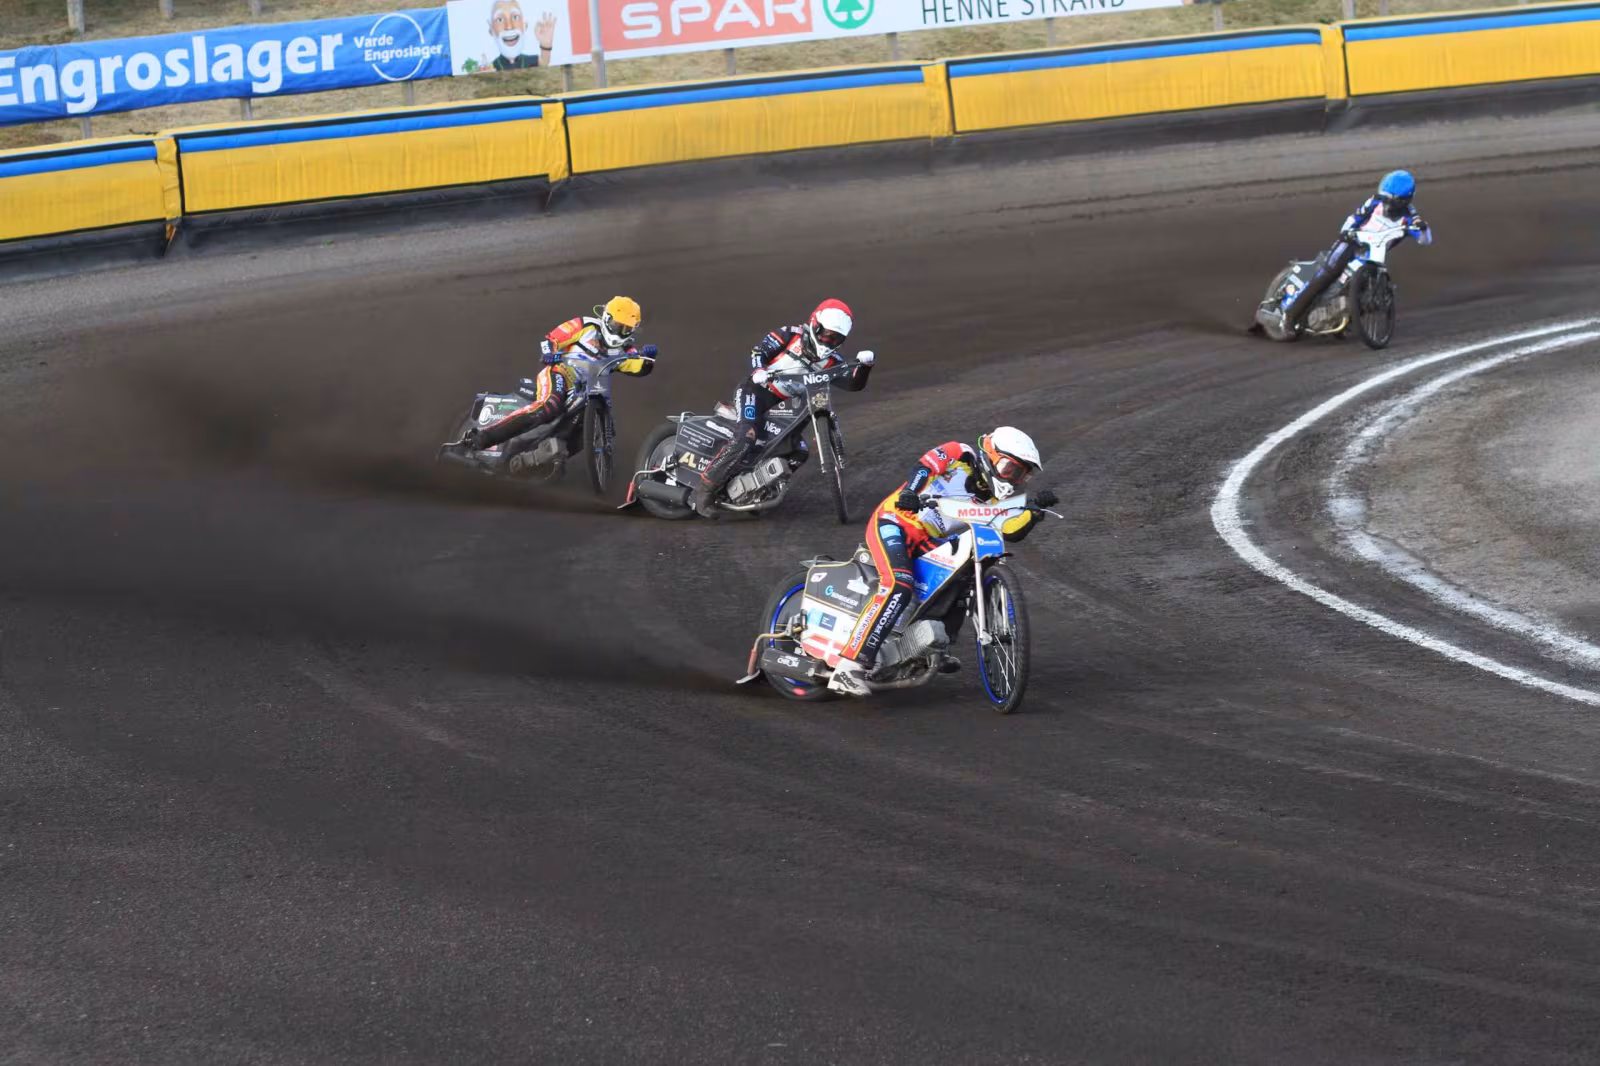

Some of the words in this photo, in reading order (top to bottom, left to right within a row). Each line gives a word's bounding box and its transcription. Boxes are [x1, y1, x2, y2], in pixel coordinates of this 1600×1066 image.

[621, 0, 806, 40] SPAR
[922, 0, 1010, 24] HENNE
[1021, 0, 1124, 16] STR
[353, 34, 394, 49] Varde
[364, 44, 443, 63] Engroslager
[0, 32, 343, 114] Engroslager
[803, 373, 830, 386] Nice
[764, 421, 782, 435] Nice
[957, 508, 1009, 517] MOLDOW
[876, 592, 903, 634] HONDA
